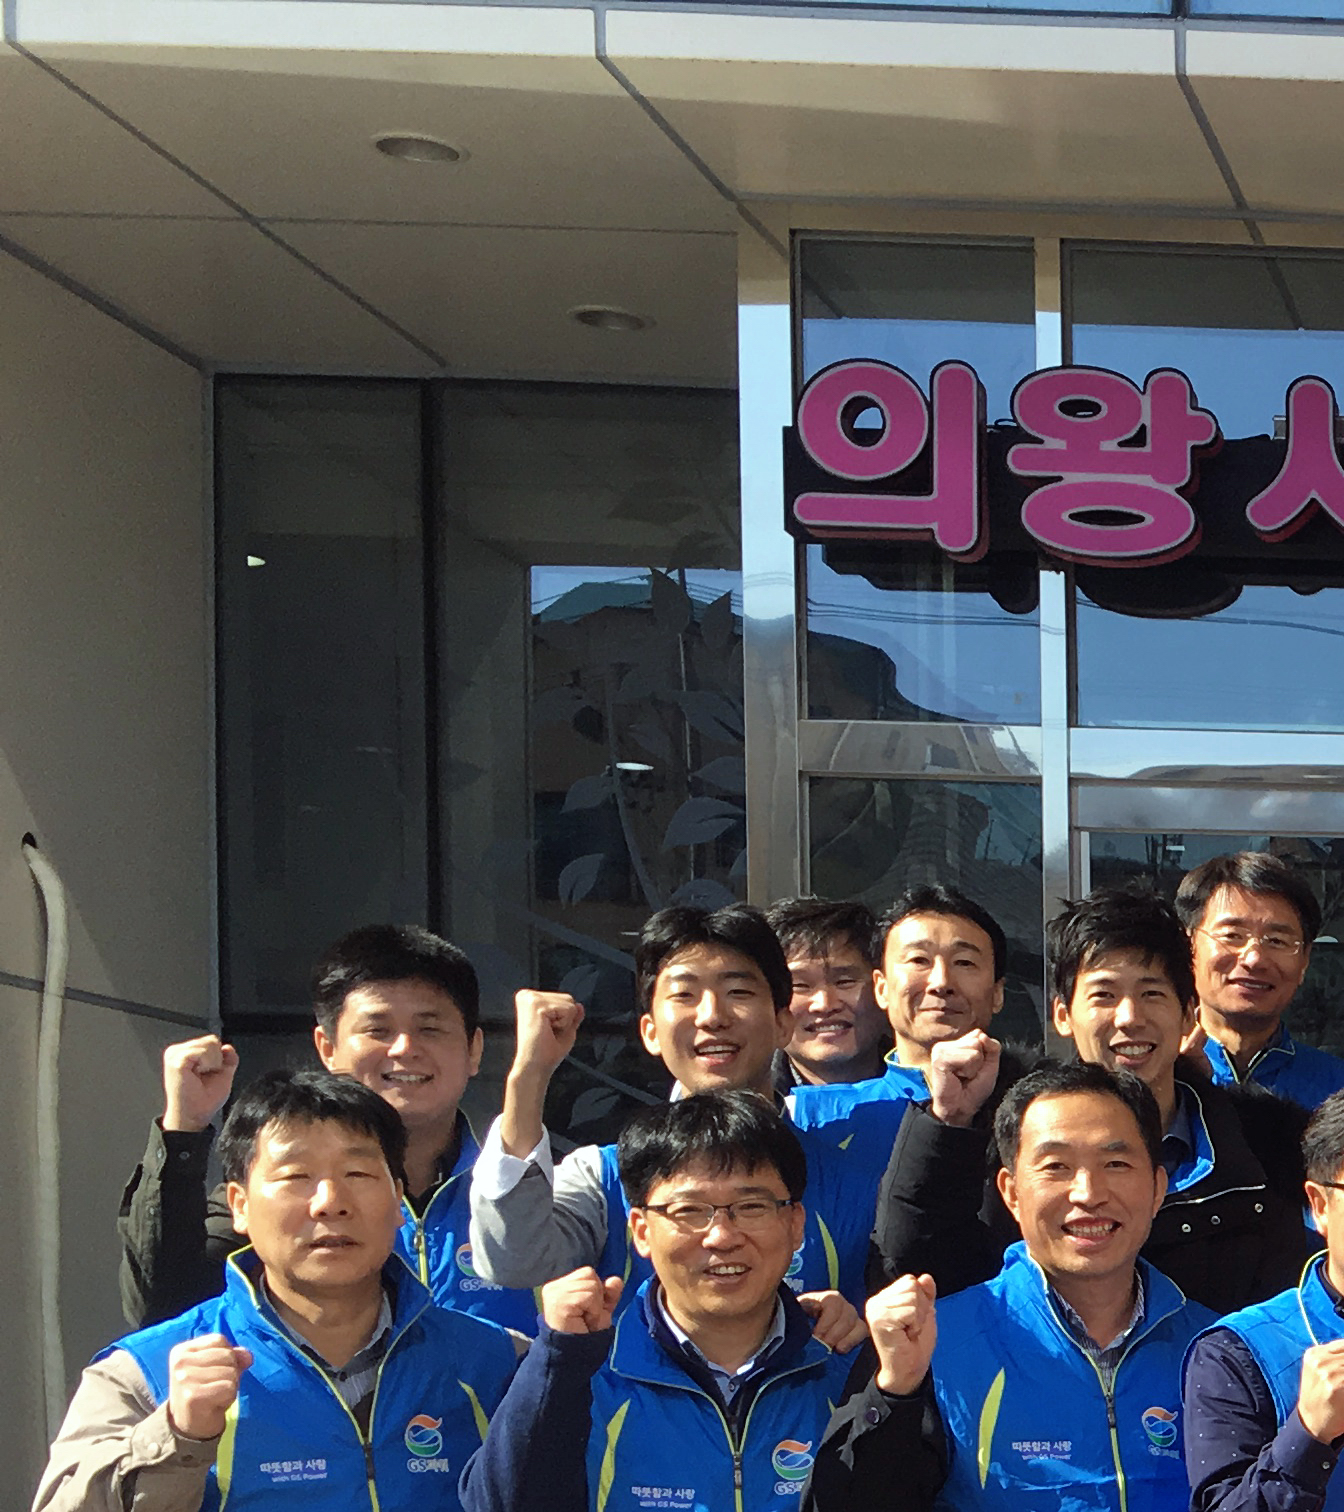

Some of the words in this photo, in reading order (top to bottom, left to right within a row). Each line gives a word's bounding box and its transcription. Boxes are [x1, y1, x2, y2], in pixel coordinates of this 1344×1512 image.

[1012, 1440, 1051, 1453] 따뜻함과
[1053, 1440, 1072, 1452] 사랑
[260, 1461, 305, 1474] 따뜻함과
[305, 1458, 327, 1471] 사랑
[407, 1458, 450, 1473] GS파워
[632, 1486, 672, 1499] 따뜻함과
[674, 1487, 696, 1500] 사랑
[670, 1501, 693, 1509] Power
